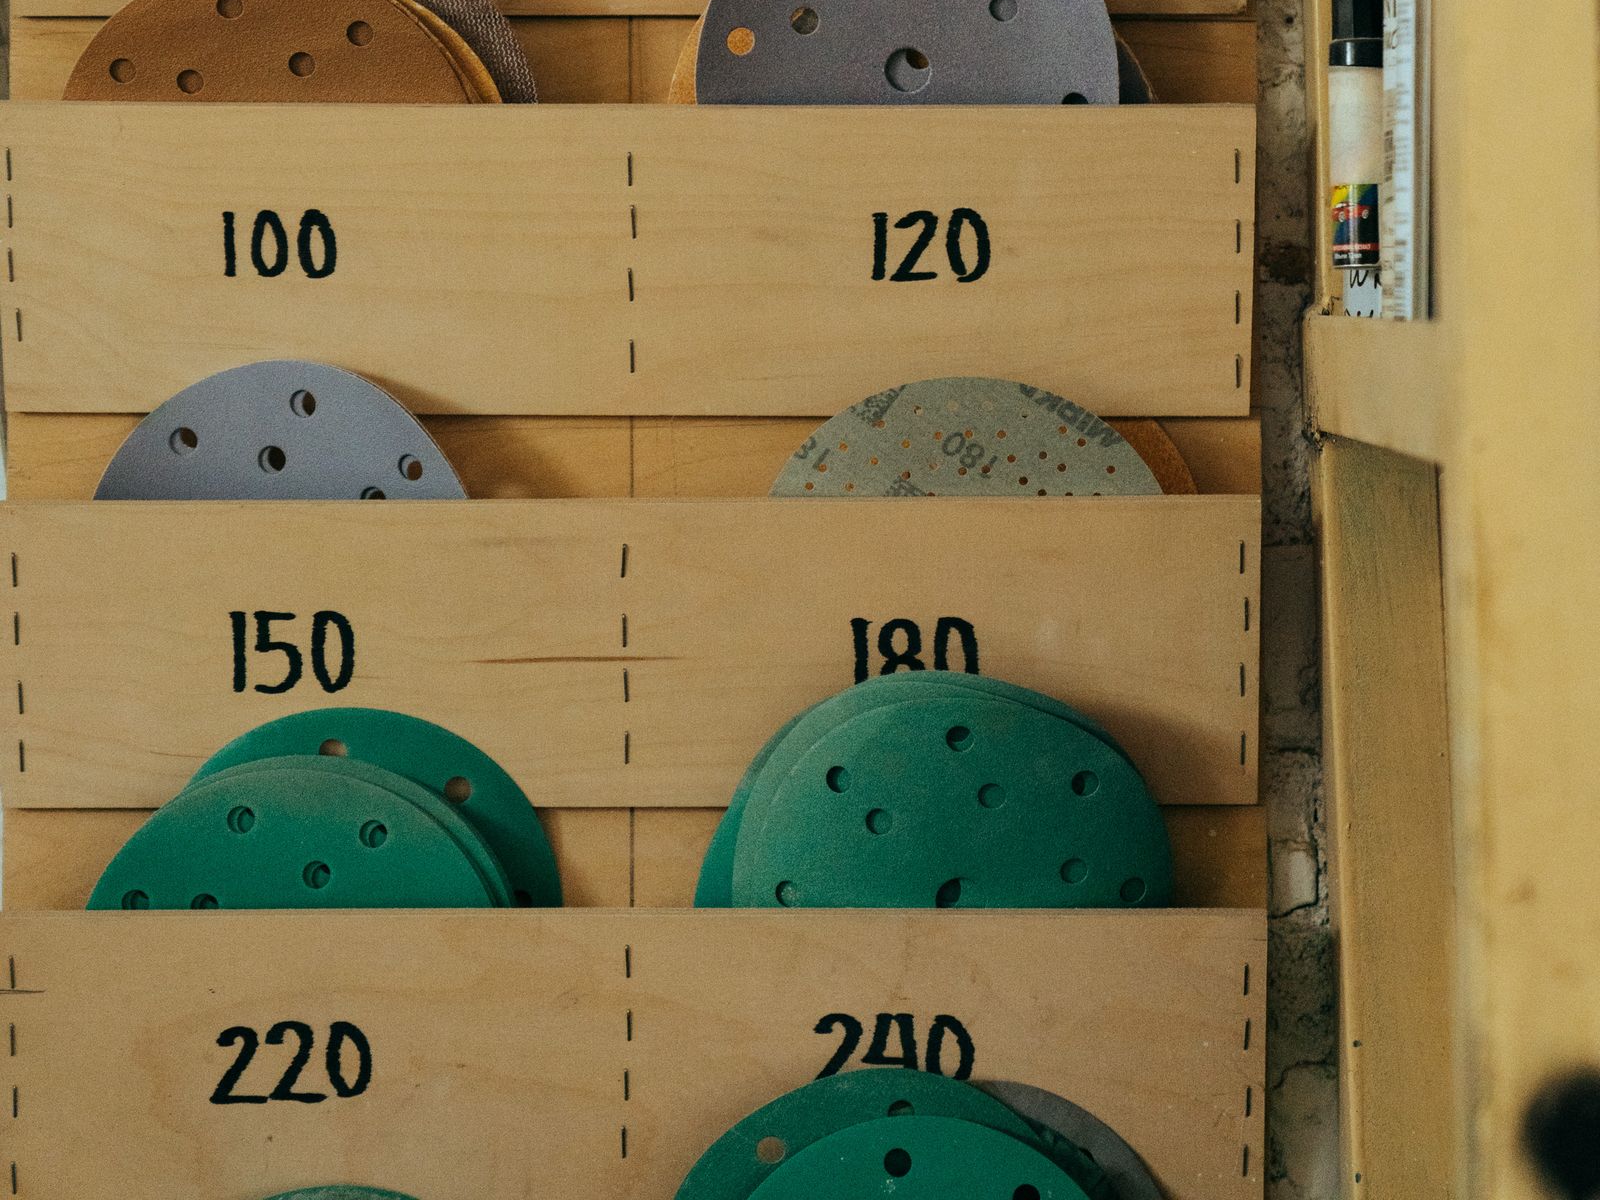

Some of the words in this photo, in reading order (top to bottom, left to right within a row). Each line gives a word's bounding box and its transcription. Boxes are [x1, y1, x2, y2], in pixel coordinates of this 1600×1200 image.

[222, 208, 337, 279] 100
[871, 207, 991, 283] 120
[229, 610, 355, 695] 150
[850, 616, 980, 686] 180
[209, 1019, 374, 1105] 220
[812, 1012, 976, 1081] 240
